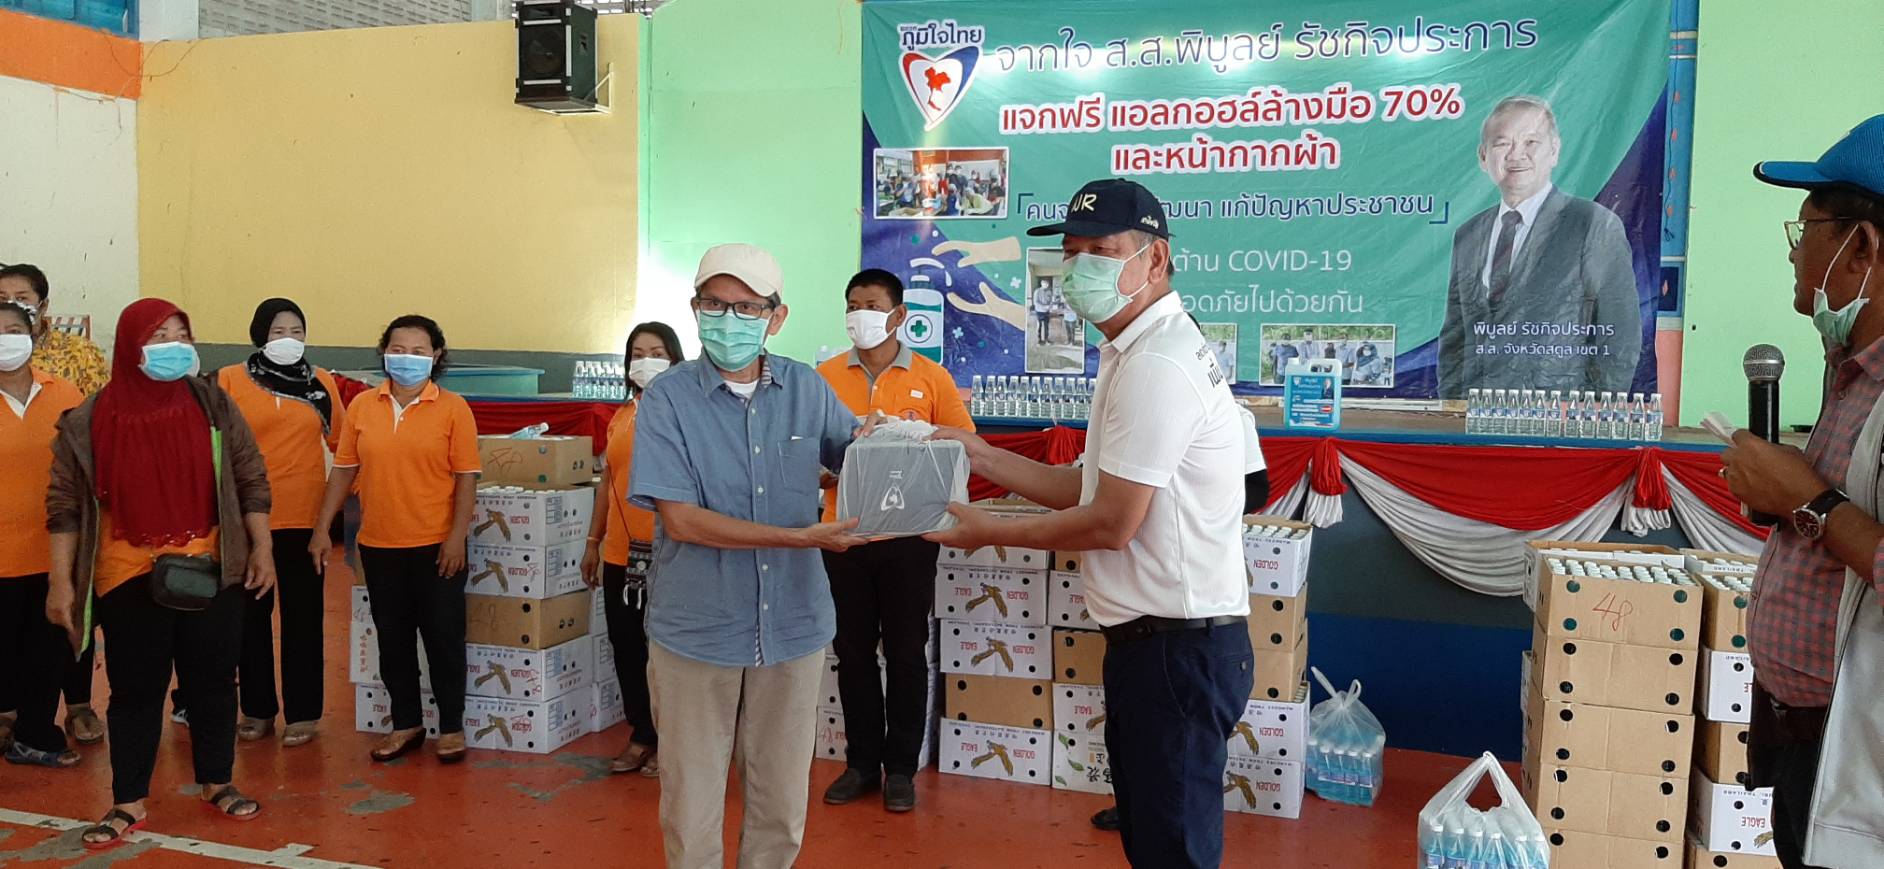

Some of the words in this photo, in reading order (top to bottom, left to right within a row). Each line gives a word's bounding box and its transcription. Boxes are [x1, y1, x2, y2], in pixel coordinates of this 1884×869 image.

[902, 22, 982, 51] ภูมิใจไทย
[996, 27, 1093, 71] จากใจ
[1106, 23, 1284, 72] ส.ส.พิบูลย์
[1295, 16, 1538, 58] รัชกิจประการ
[1002, 97, 1102, 131] แจกฟรี
[1383, 87, 1461, 117] 70%
[1114, 133, 1336, 171] และหน้ากากผ้า
[1221, 192, 1434, 220] แก้ปัญหาประชาชน
[1228, 249, 1352, 272] COVID-19
[1181, 284, 1364, 313] อดภัยไปด้วยกัน
[1473, 321, 1518, 340] พิบูลย์
[1521, 321, 1615, 336] รัชกิจประการ
[1475, 345, 1500, 355] ส.ส.
[1503, 343, 1573, 358] จังหวัดสตูล
[1576, 345, 1598, 356] เขต
[1602, 345, 1610, 355] 1
[1253, 559, 1279, 570] GOLDEN
[954, 586, 973, 597] EAGLE
[1007, 590, 1029, 600] GOLDEN
[1592, 592, 1633, 632] 48
[960, 640, 978, 651] EAGLE
[1013, 644, 1035, 655] GOLDEN
[1074, 705, 1094, 715] EAGLE
[1260, 727, 1284, 737] GOLDEN
[960, 742, 978, 753] EAGLE
[1013, 748, 1036, 759] GOLDEN
[1256, 781, 1281, 792] GOLDEN
[1741, 816, 1766, 828] EAGLE
